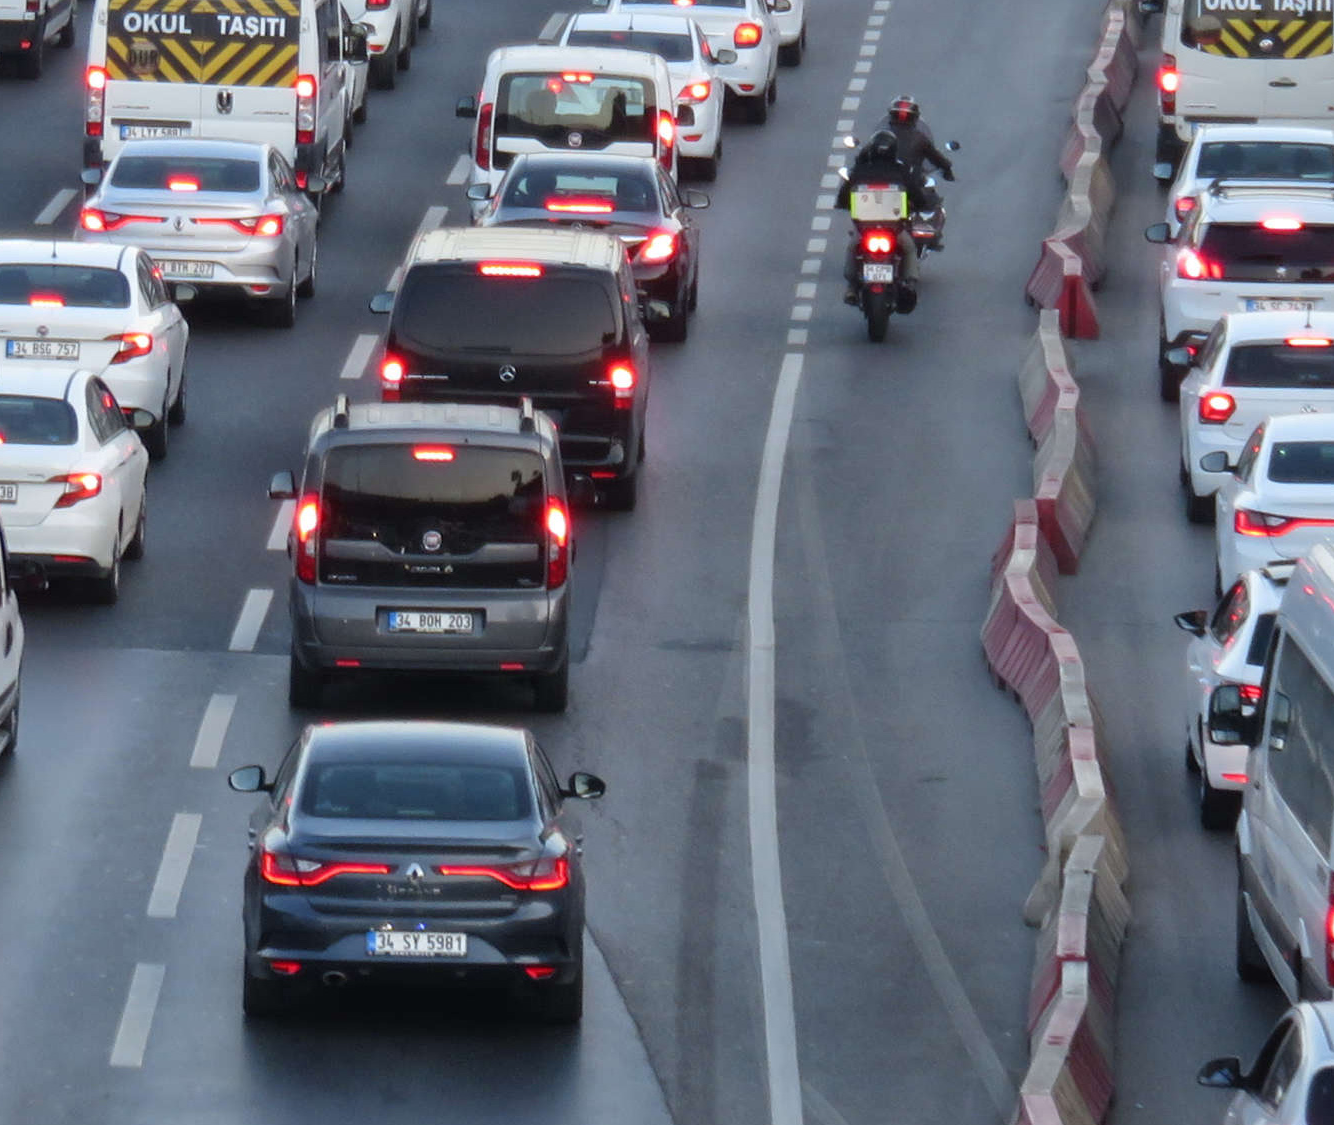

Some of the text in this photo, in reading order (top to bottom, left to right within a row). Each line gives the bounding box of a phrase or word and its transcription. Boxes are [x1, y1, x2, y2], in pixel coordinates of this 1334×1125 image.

[122, 12, 287, 39] OKUL TAŞITI
[15, 342, 27, 355] 34
[397, 613, 411, 627] 34
[449, 615, 471, 629] 203
[378, 933, 463, 952] 34 SY 5981
